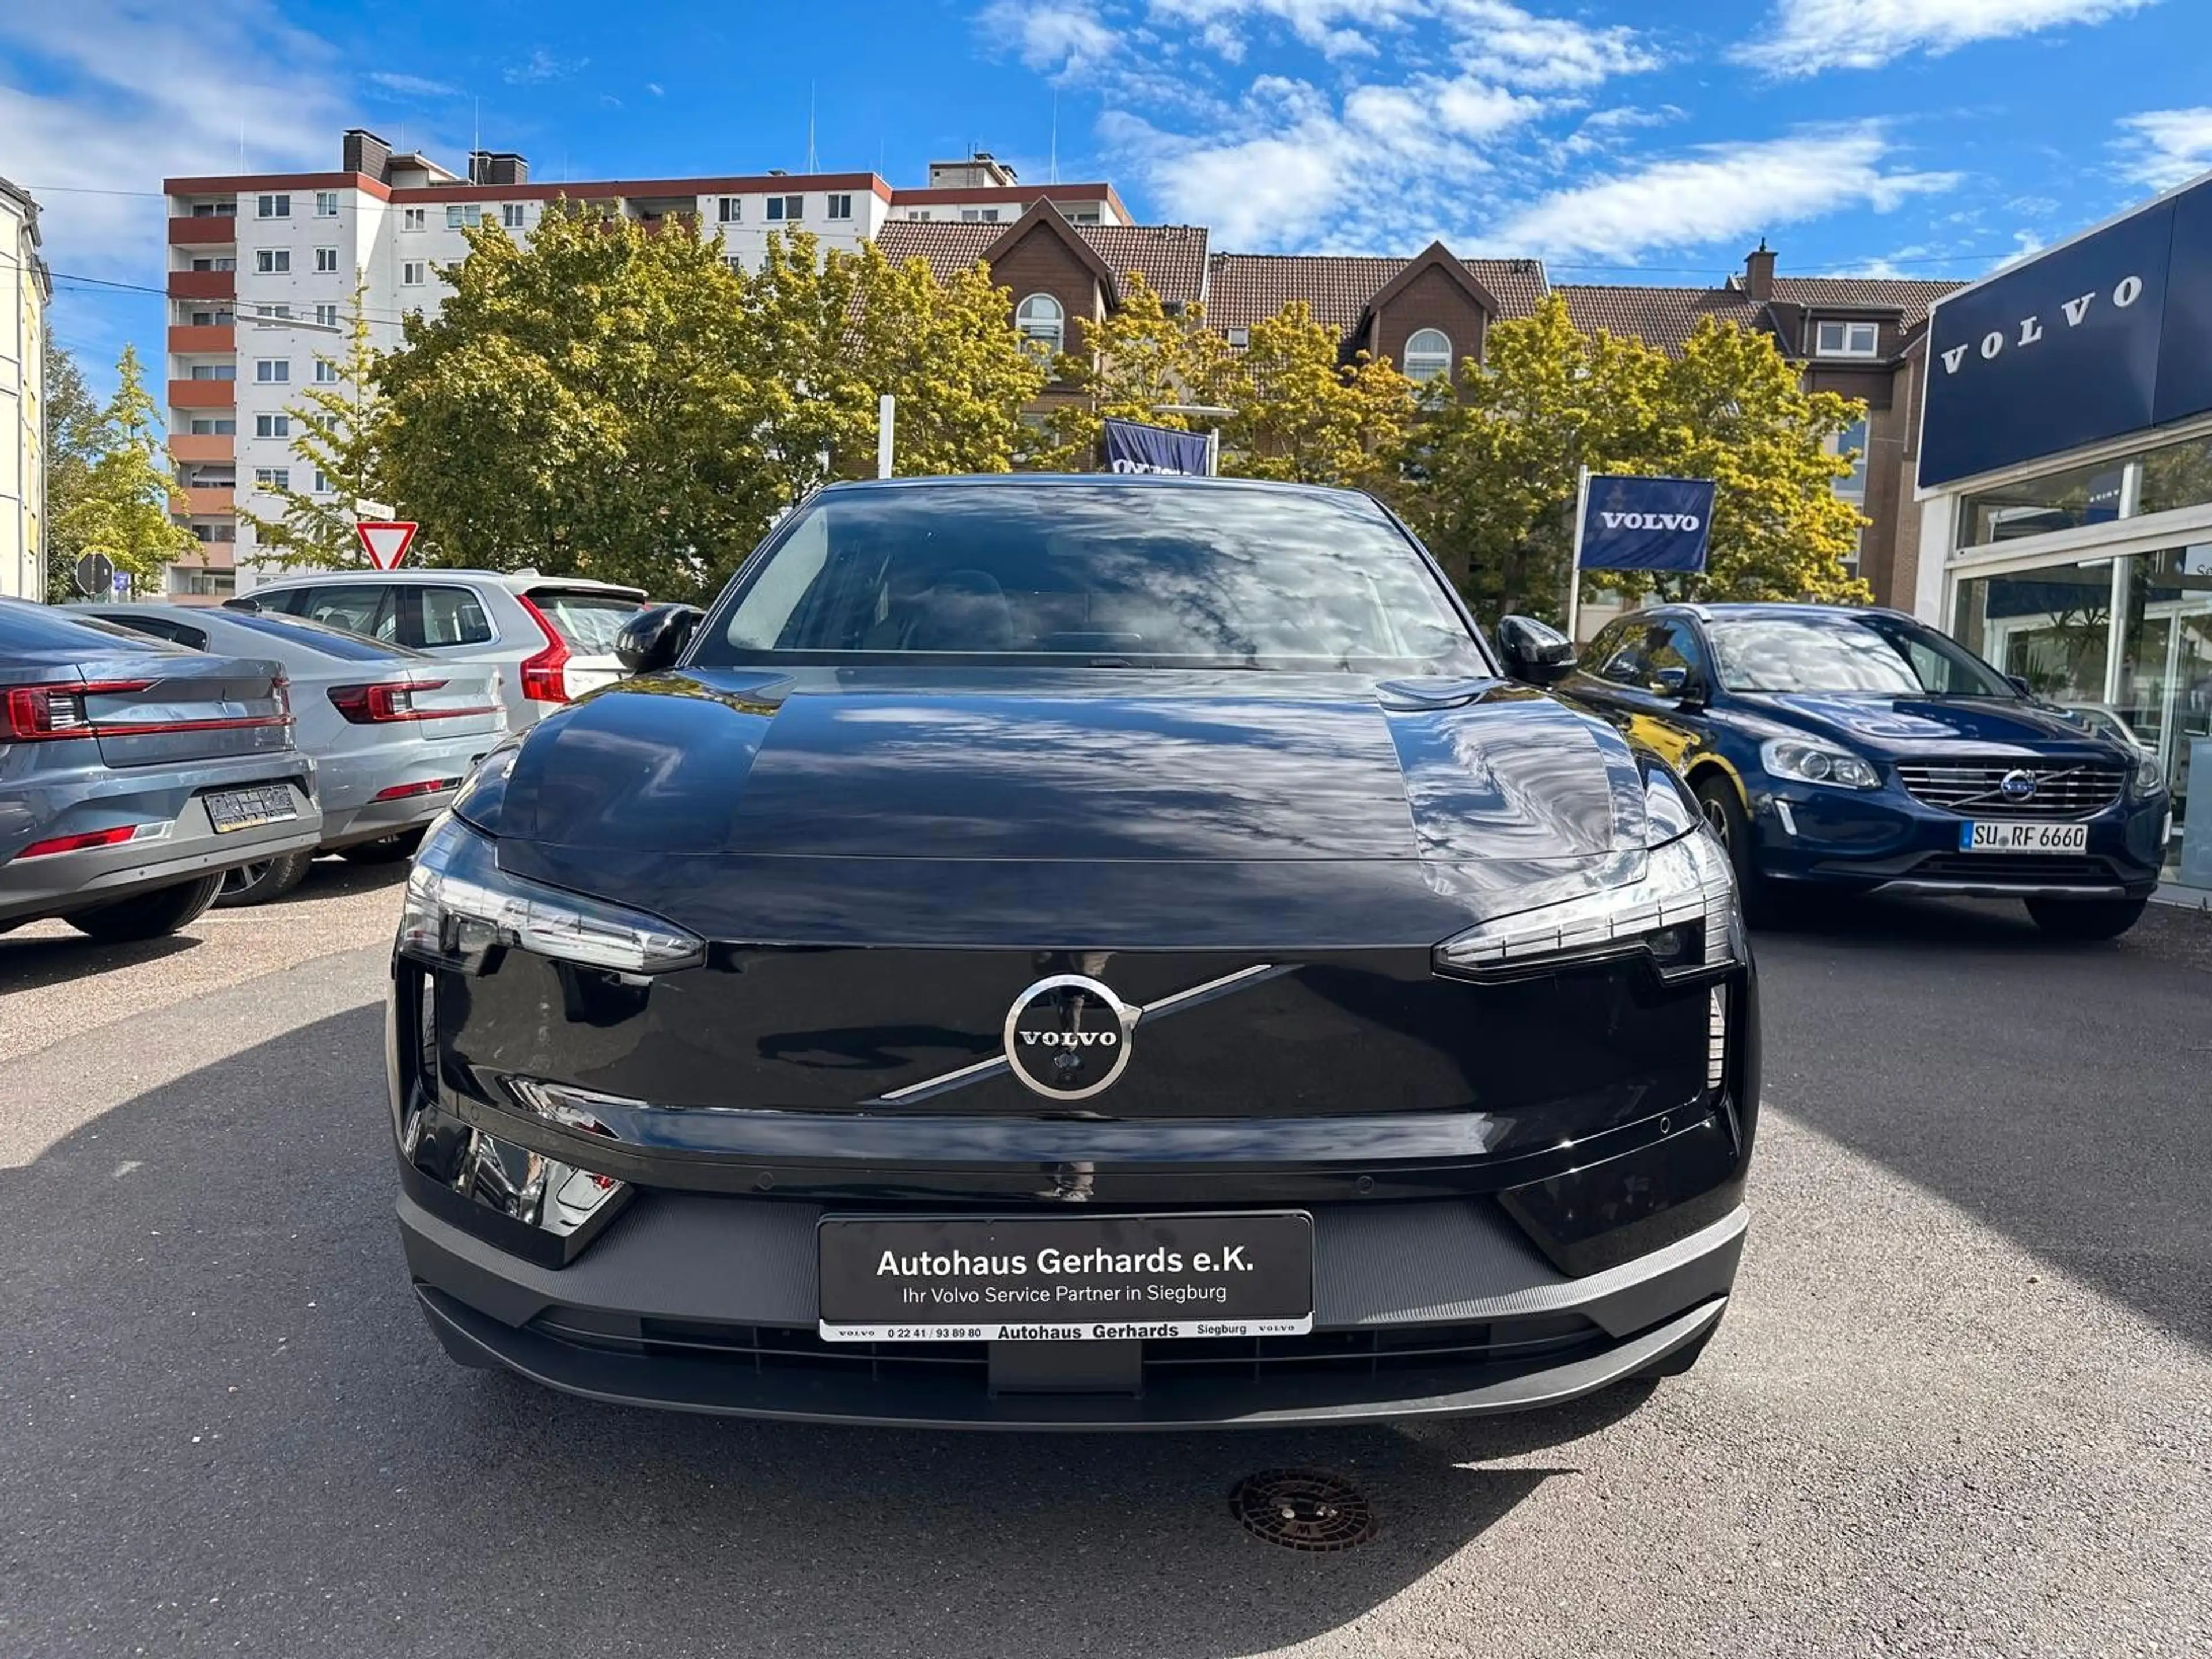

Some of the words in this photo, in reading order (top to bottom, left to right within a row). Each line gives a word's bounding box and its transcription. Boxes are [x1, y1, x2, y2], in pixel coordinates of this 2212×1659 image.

[1941, 276, 2143, 374] VOLVO
[1600, 512, 1700, 532] VOLVO
[1974, 825, 1998, 846] SU
[2012, 827, 2036, 847] RF
[2039, 827, 2084, 847] 6660
[1019, 1031, 1117, 1046] VOLVO
[876, 1249, 1027, 1275] Autohaus
[1036, 1246, 1183, 1274] Gerhards
[1192, 1245, 1254, 1272] e.K.
[903, 1288, 926, 1304] Ihr
[930, 1287, 980, 1304] Volvo
[984, 1286, 1051, 1303] Service
[1055, 1285, 1122, 1302] Partner
[1126, 1285, 1142, 1301] in
[1147, 1284, 1227, 1304] Siegburg
[998, 1325, 1082, 1339] Autohaus
[1092, 1323, 1179, 1338] Gerhards
[1197, 1324, 1247, 1335] Siegburg
